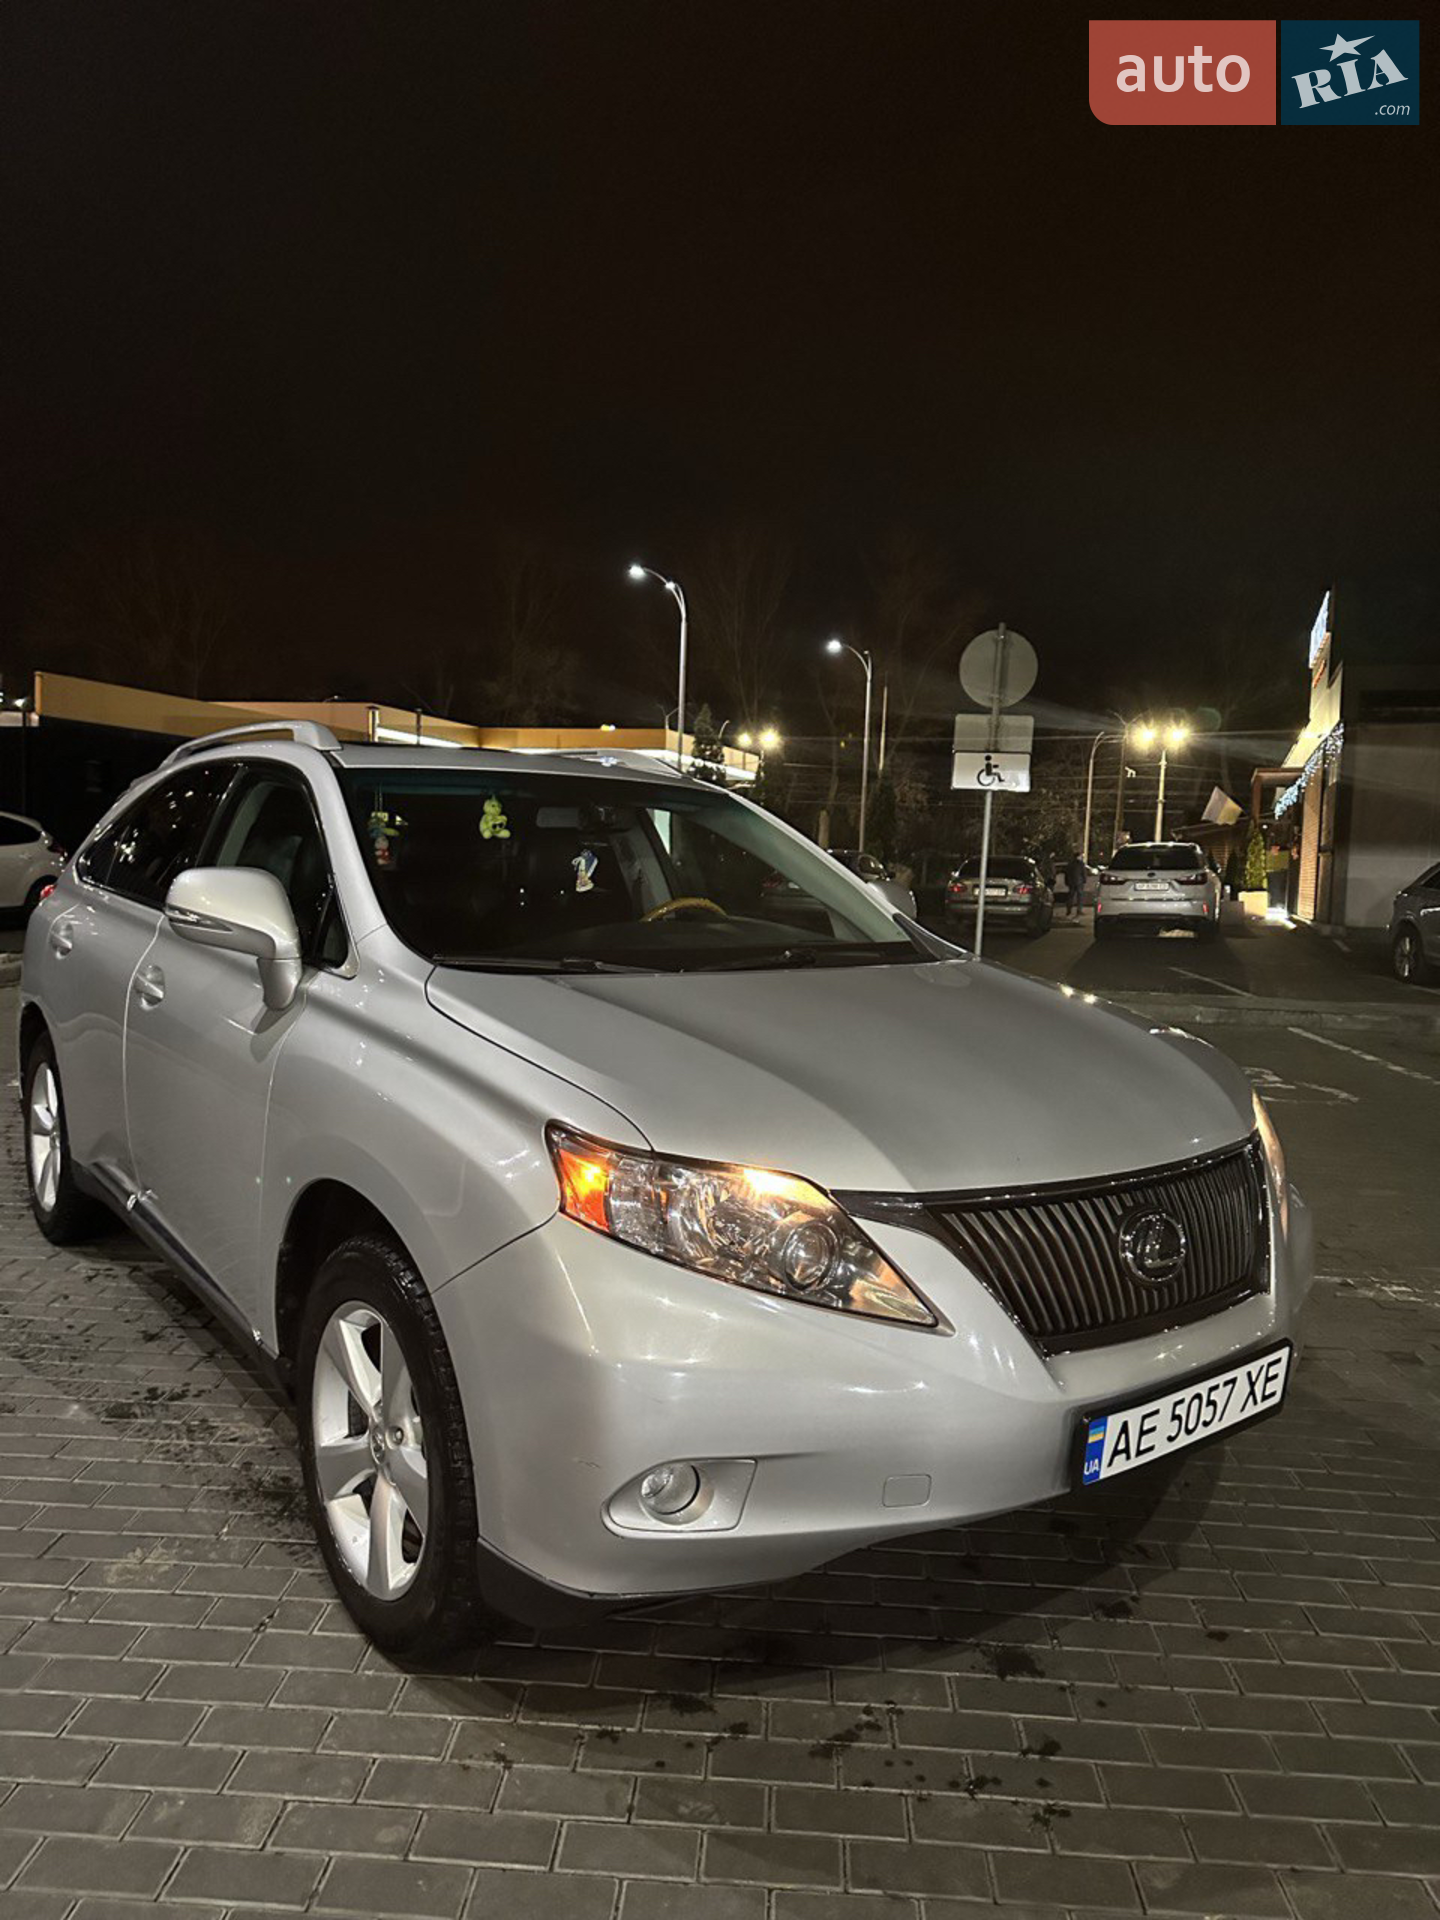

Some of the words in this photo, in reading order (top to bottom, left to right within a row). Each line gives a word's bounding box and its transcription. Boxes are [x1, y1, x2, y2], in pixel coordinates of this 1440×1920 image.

[1107, 1408, 1160, 1468] AE
[1166, 1376, 1238, 1443] 5057
[1240, 1356, 1282, 1413] XE
[1083, 1457, 1100, 1475] UA
